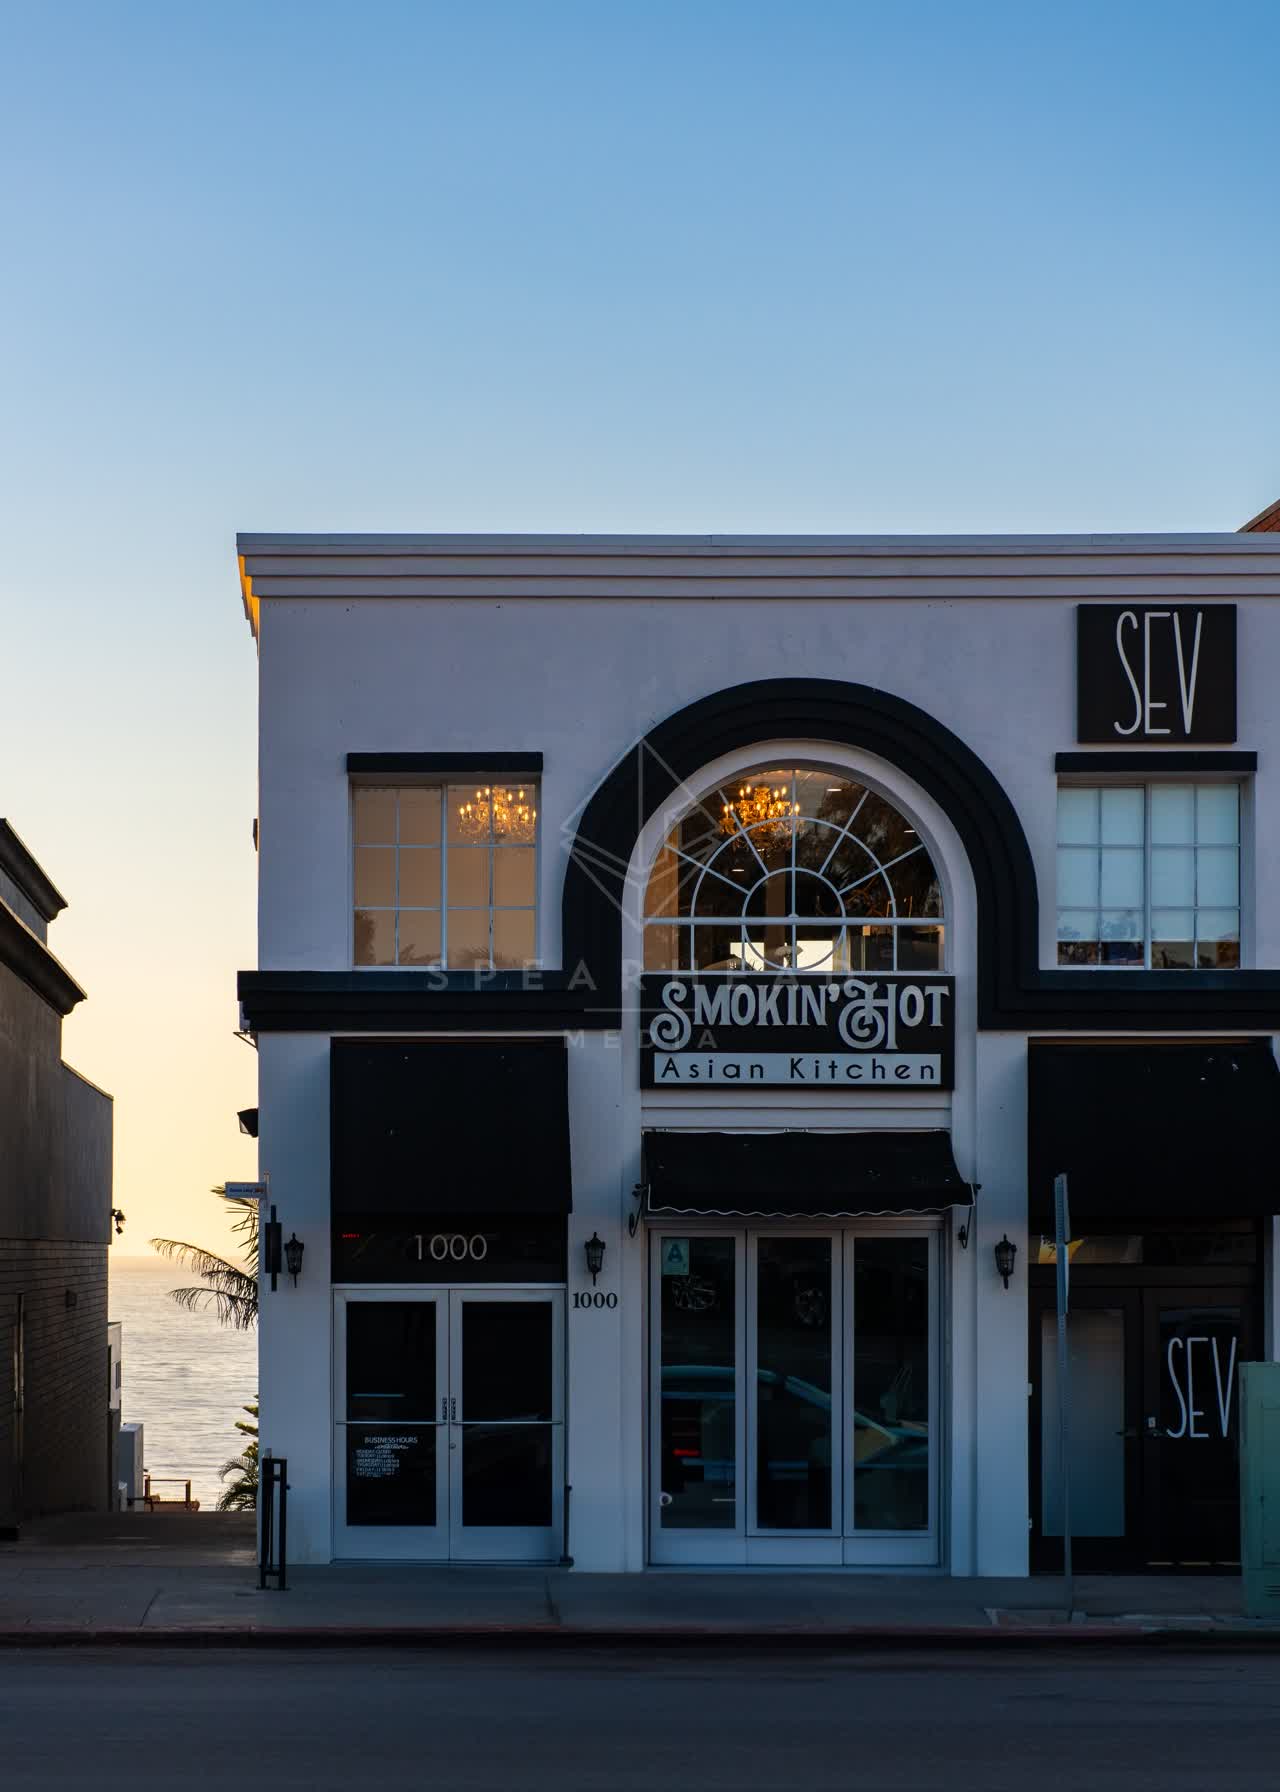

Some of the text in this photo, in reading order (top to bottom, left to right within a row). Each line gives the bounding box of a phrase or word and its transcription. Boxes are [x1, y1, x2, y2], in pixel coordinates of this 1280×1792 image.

[1113, 611, 1203, 735] SEV
[661, 1057, 935, 1080] Asian Kitchen
[415, 1233, 488, 1261] 1000
[668, 1243, 683, 1262] A
[572, 1291, 618, 1309] 1000
[1166, 1336, 1238, 1439] SEV
[364, 1436, 418, 1444] BUSINESS HOURS
